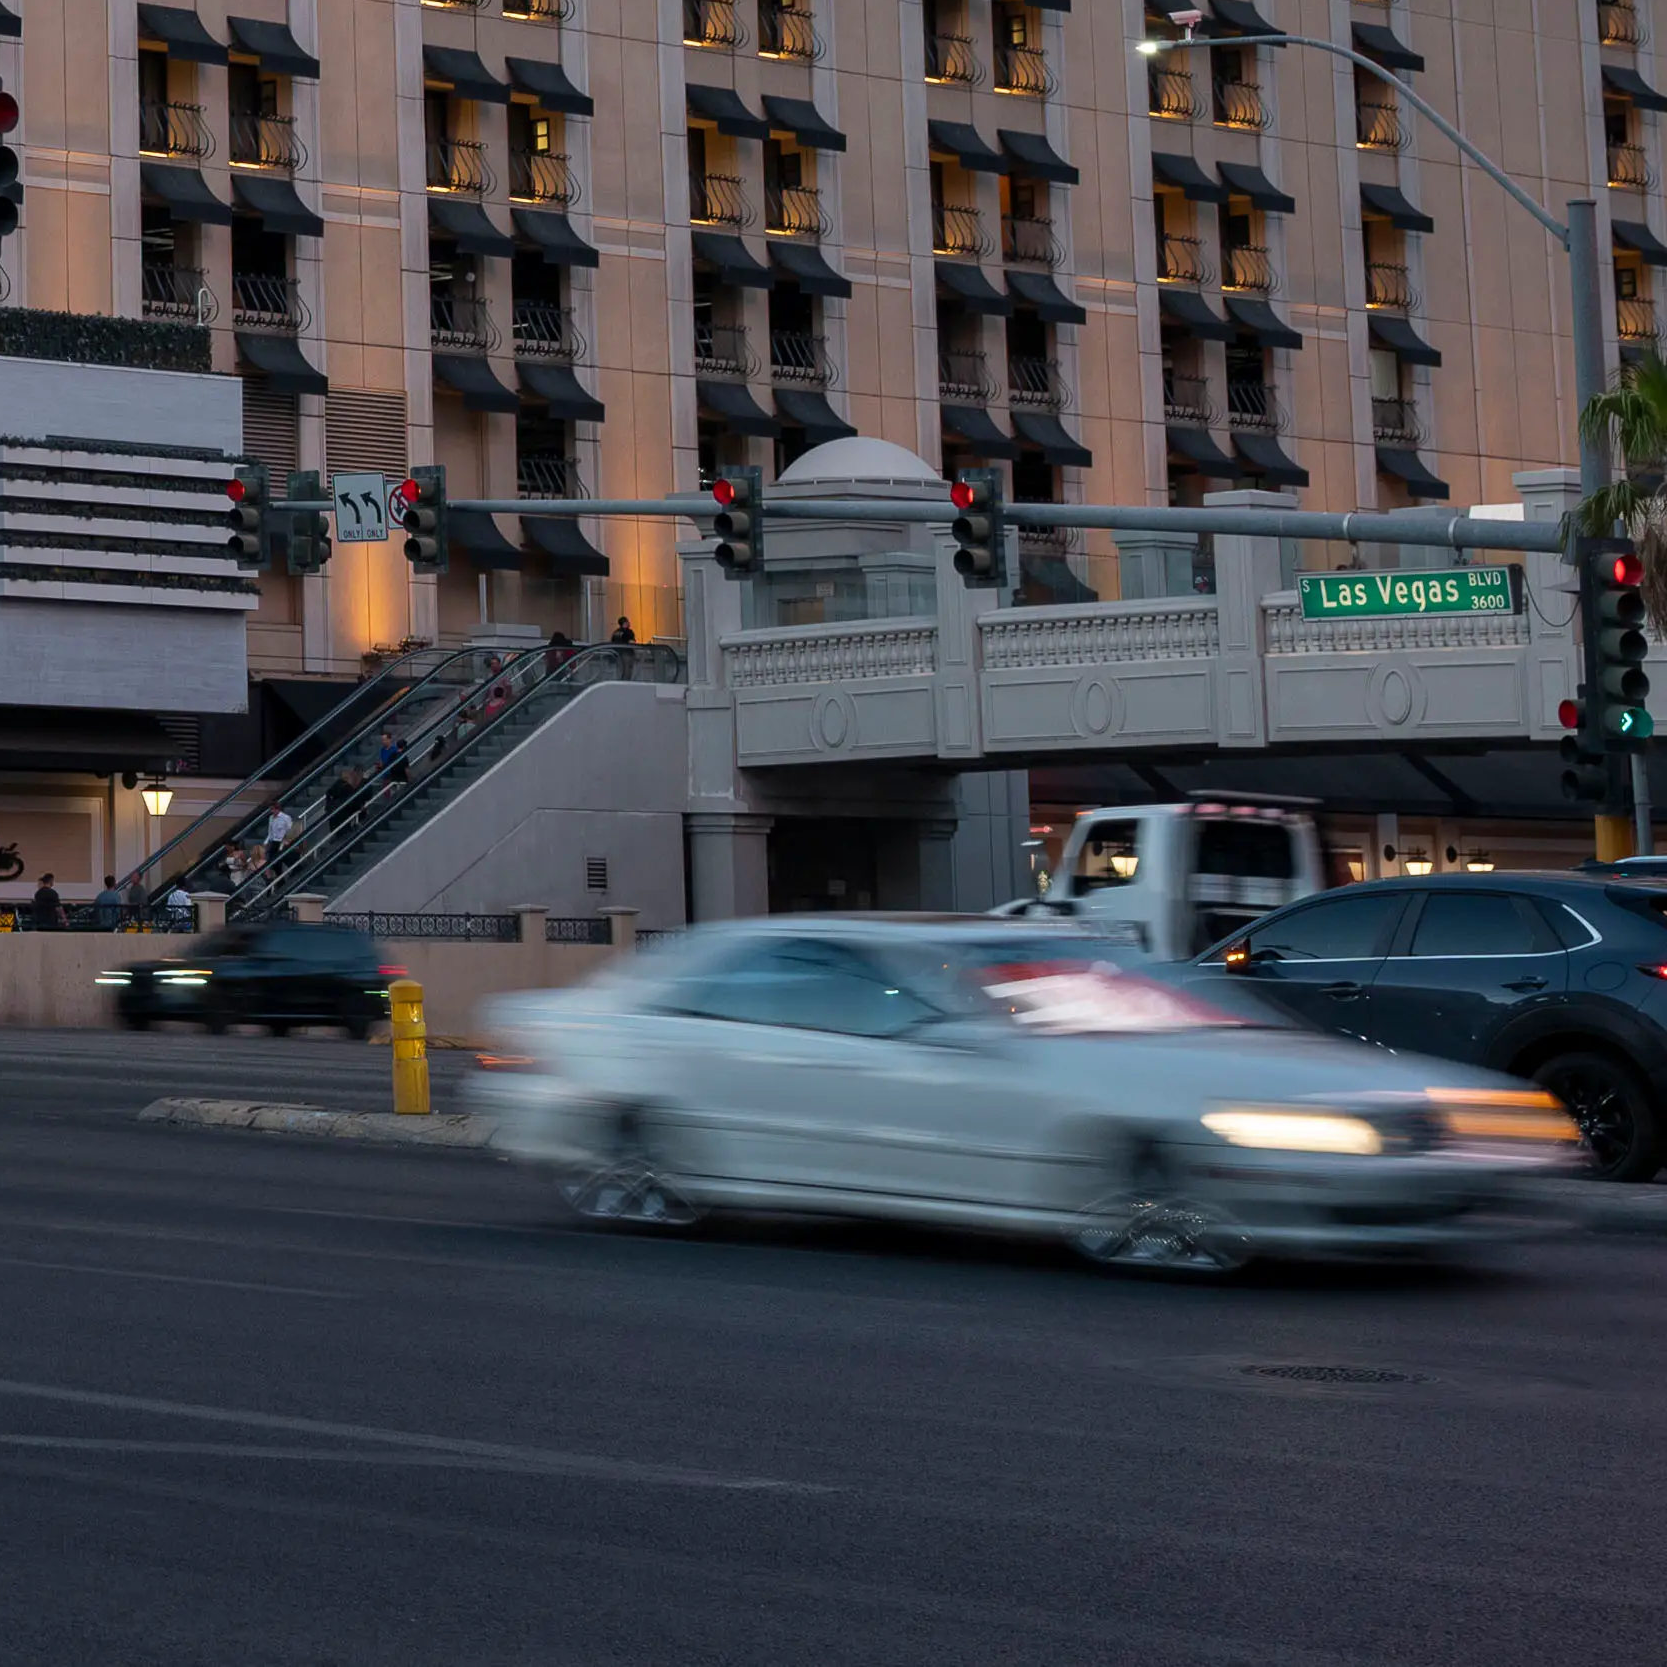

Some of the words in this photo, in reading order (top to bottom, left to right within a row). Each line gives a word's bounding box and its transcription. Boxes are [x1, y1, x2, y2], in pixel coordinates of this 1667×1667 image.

[343, 529, 360, 538] ONLY
[366, 528, 383, 538] ONLY
[1302, 580, 1310, 592] S
[1320, 580, 1367, 608] Las
[1375, 575, 1460, 612] Vegas
[1468, 572, 1501, 587] BLVD
[1471, 594, 1505, 610] 3600
